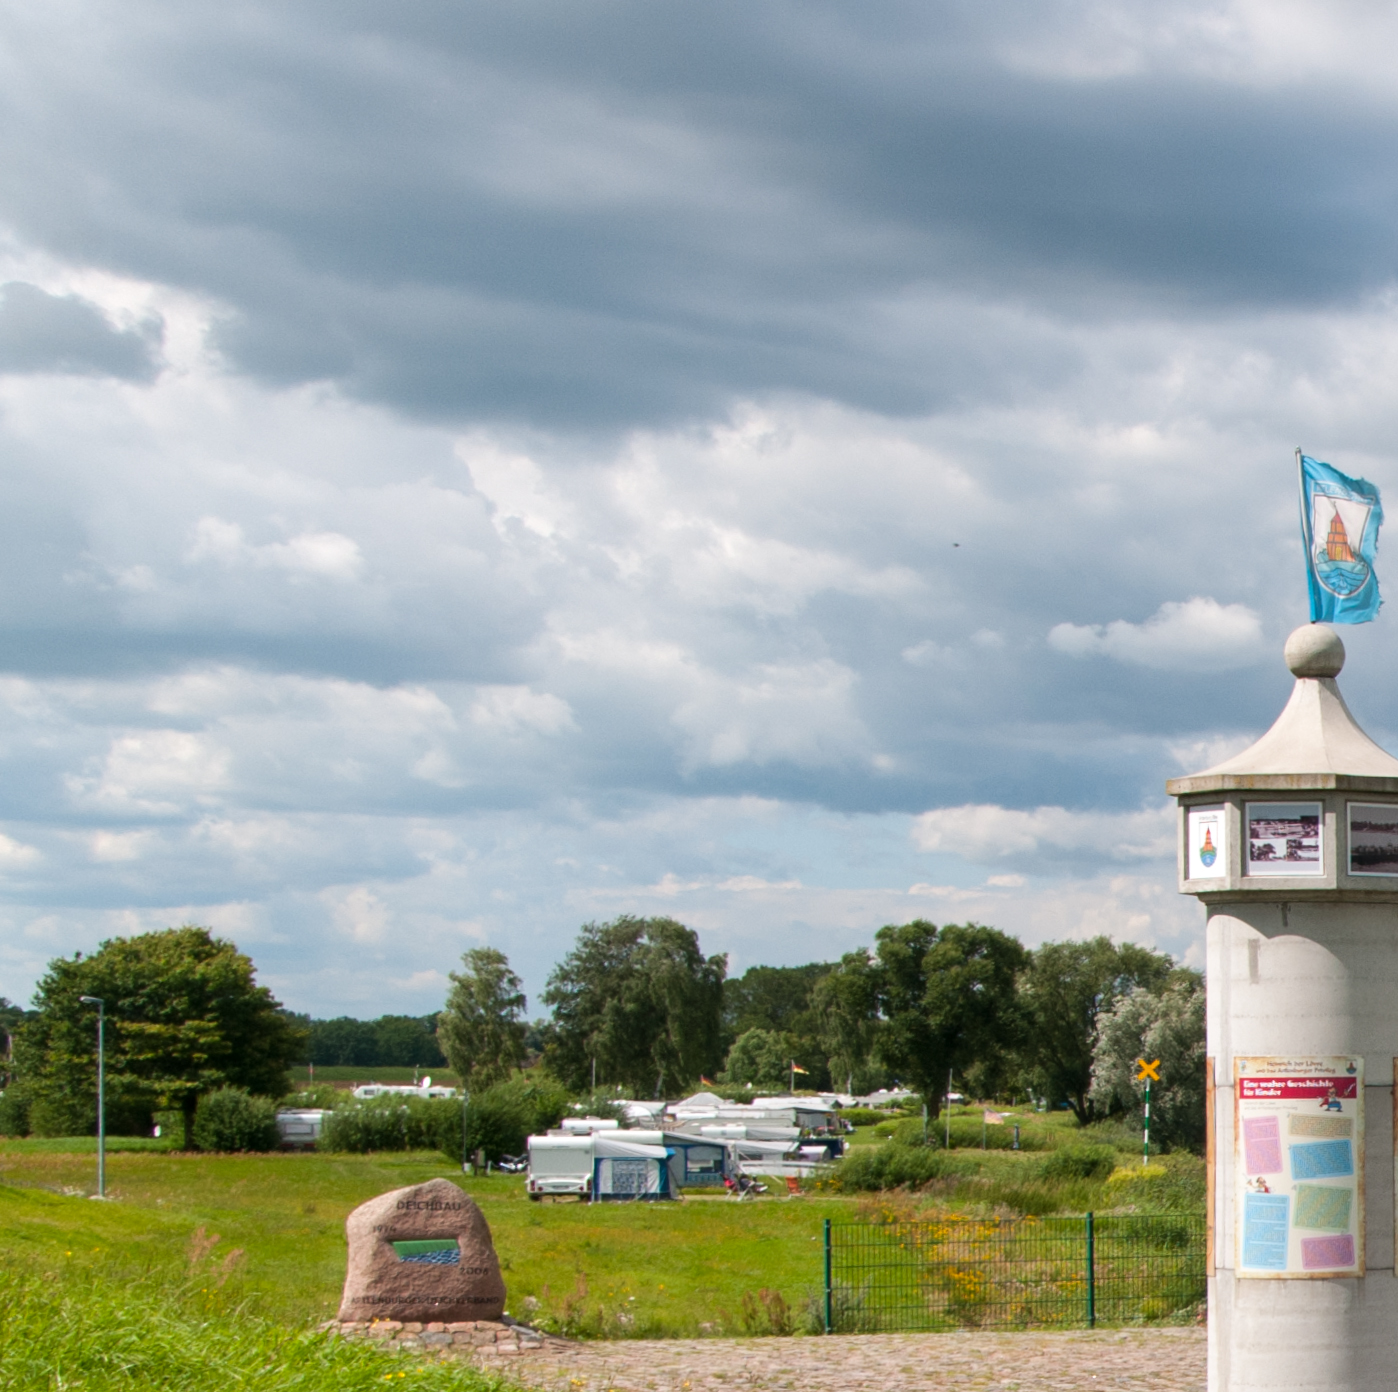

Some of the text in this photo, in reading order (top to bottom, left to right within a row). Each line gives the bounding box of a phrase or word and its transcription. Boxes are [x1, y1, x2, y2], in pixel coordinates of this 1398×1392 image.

[1286, 1080, 1334, 1088] Geschichte
[1255, 1088, 1281, 1096] Kinder
[397, 1200, 461, 1211] DEICHBAU
